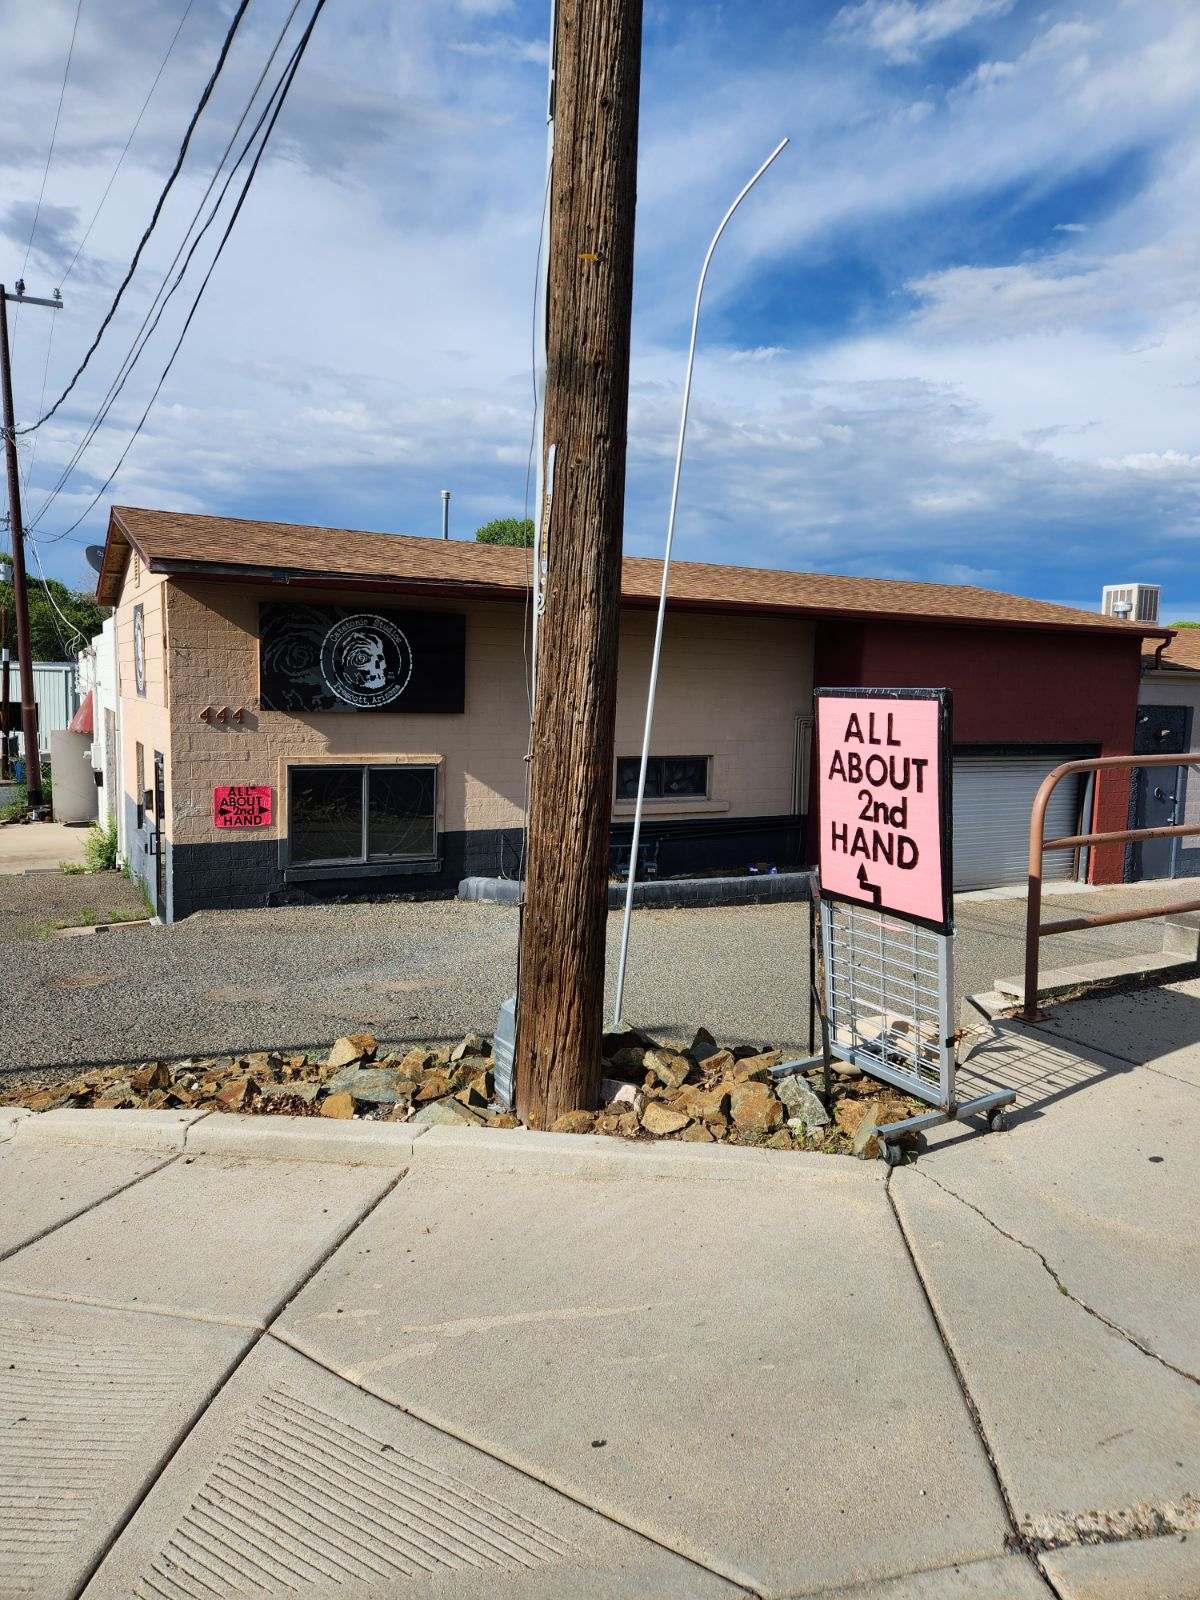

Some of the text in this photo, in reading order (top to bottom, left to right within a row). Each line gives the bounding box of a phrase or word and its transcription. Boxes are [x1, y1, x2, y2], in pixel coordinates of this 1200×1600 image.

[844, 711, 902, 747] ALL
[828, 749, 929, 793] ABOUT
[219, 796, 263, 807] ABOUT
[227, 786, 253, 797] ALL
[223, 815, 263, 826] HAND
[232, 805, 255, 816] 2nd
[857, 789, 908, 830] 2nd
[831, 820, 920, 871] HAND
